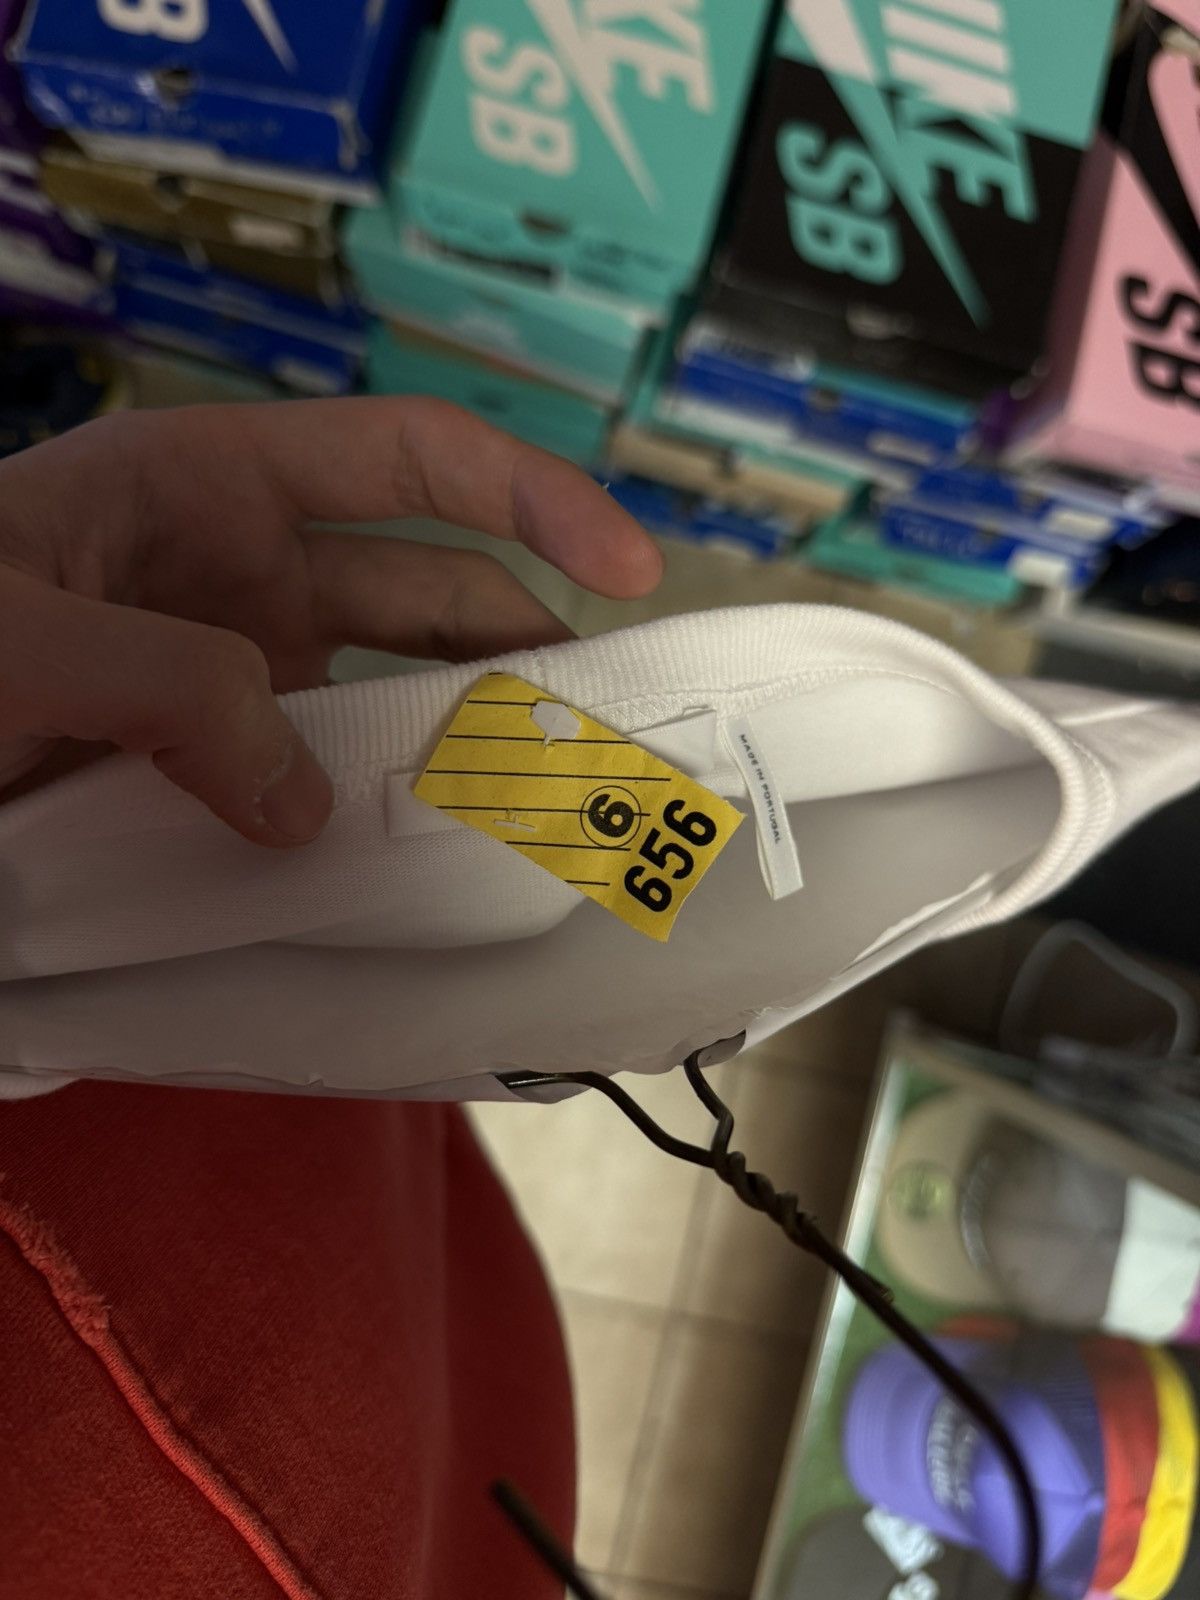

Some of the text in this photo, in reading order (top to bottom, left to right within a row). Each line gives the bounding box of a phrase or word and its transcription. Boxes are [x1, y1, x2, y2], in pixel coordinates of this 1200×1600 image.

[461, 23, 577, 178] SB
[880, 0, 1038, 223] IKE
[776, 119, 904, 286] SB
[1118, 271, 1200, 416] SB
[624, 799, 717, 912] 656
[739, 733, 782, 845] MADE IN PORTUGAL
